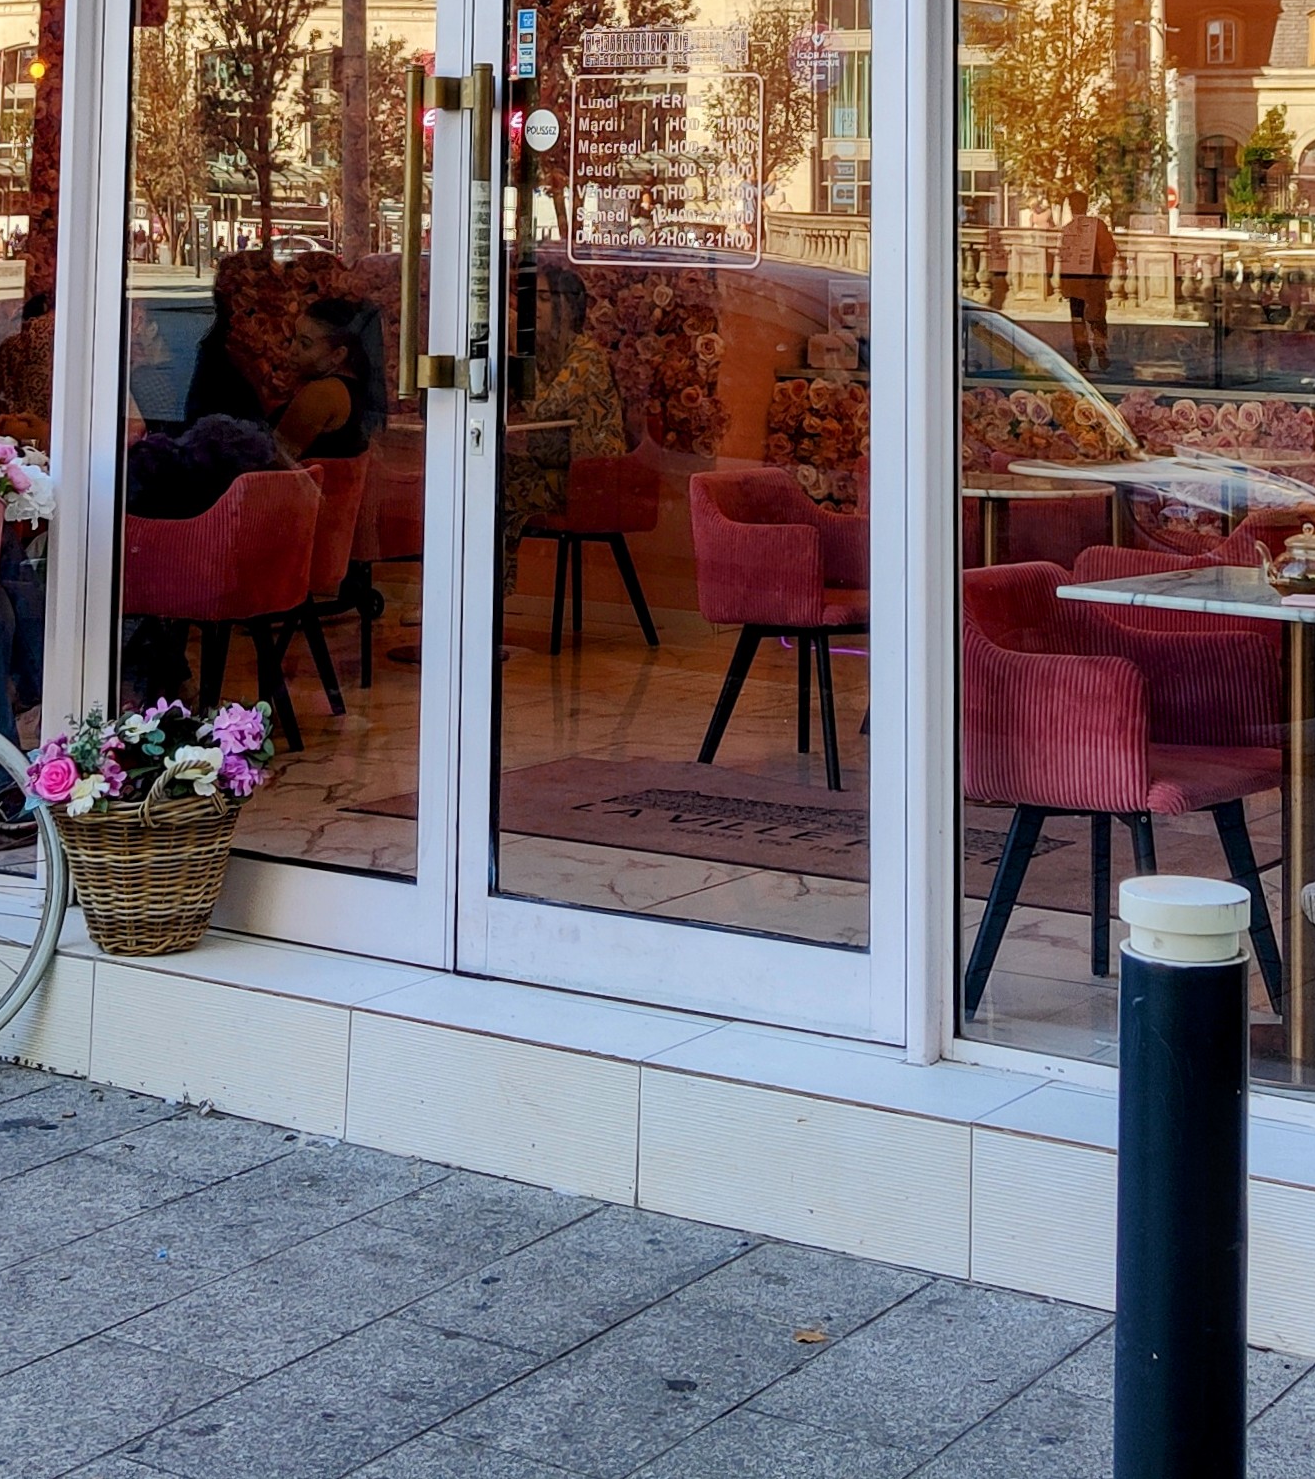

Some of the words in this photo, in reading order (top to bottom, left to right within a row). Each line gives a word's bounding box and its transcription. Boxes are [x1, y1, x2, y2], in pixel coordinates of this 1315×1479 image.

[579, 94, 618, 109] Lundi
[526, 126, 557, 136] POUSSEZ
[578, 117, 618, 132] Mardi
[578, 139, 641, 154] Mercredi
[577, 162, 616, 177] Jeudi
[576, 184, 641, 200] Vendredi
[576, 207, 629, 222] Samedi
[575, 229, 646, 246] Dimanche
[570, 802, 643, 818] LA
[668, 814, 832, 842] VILLE
